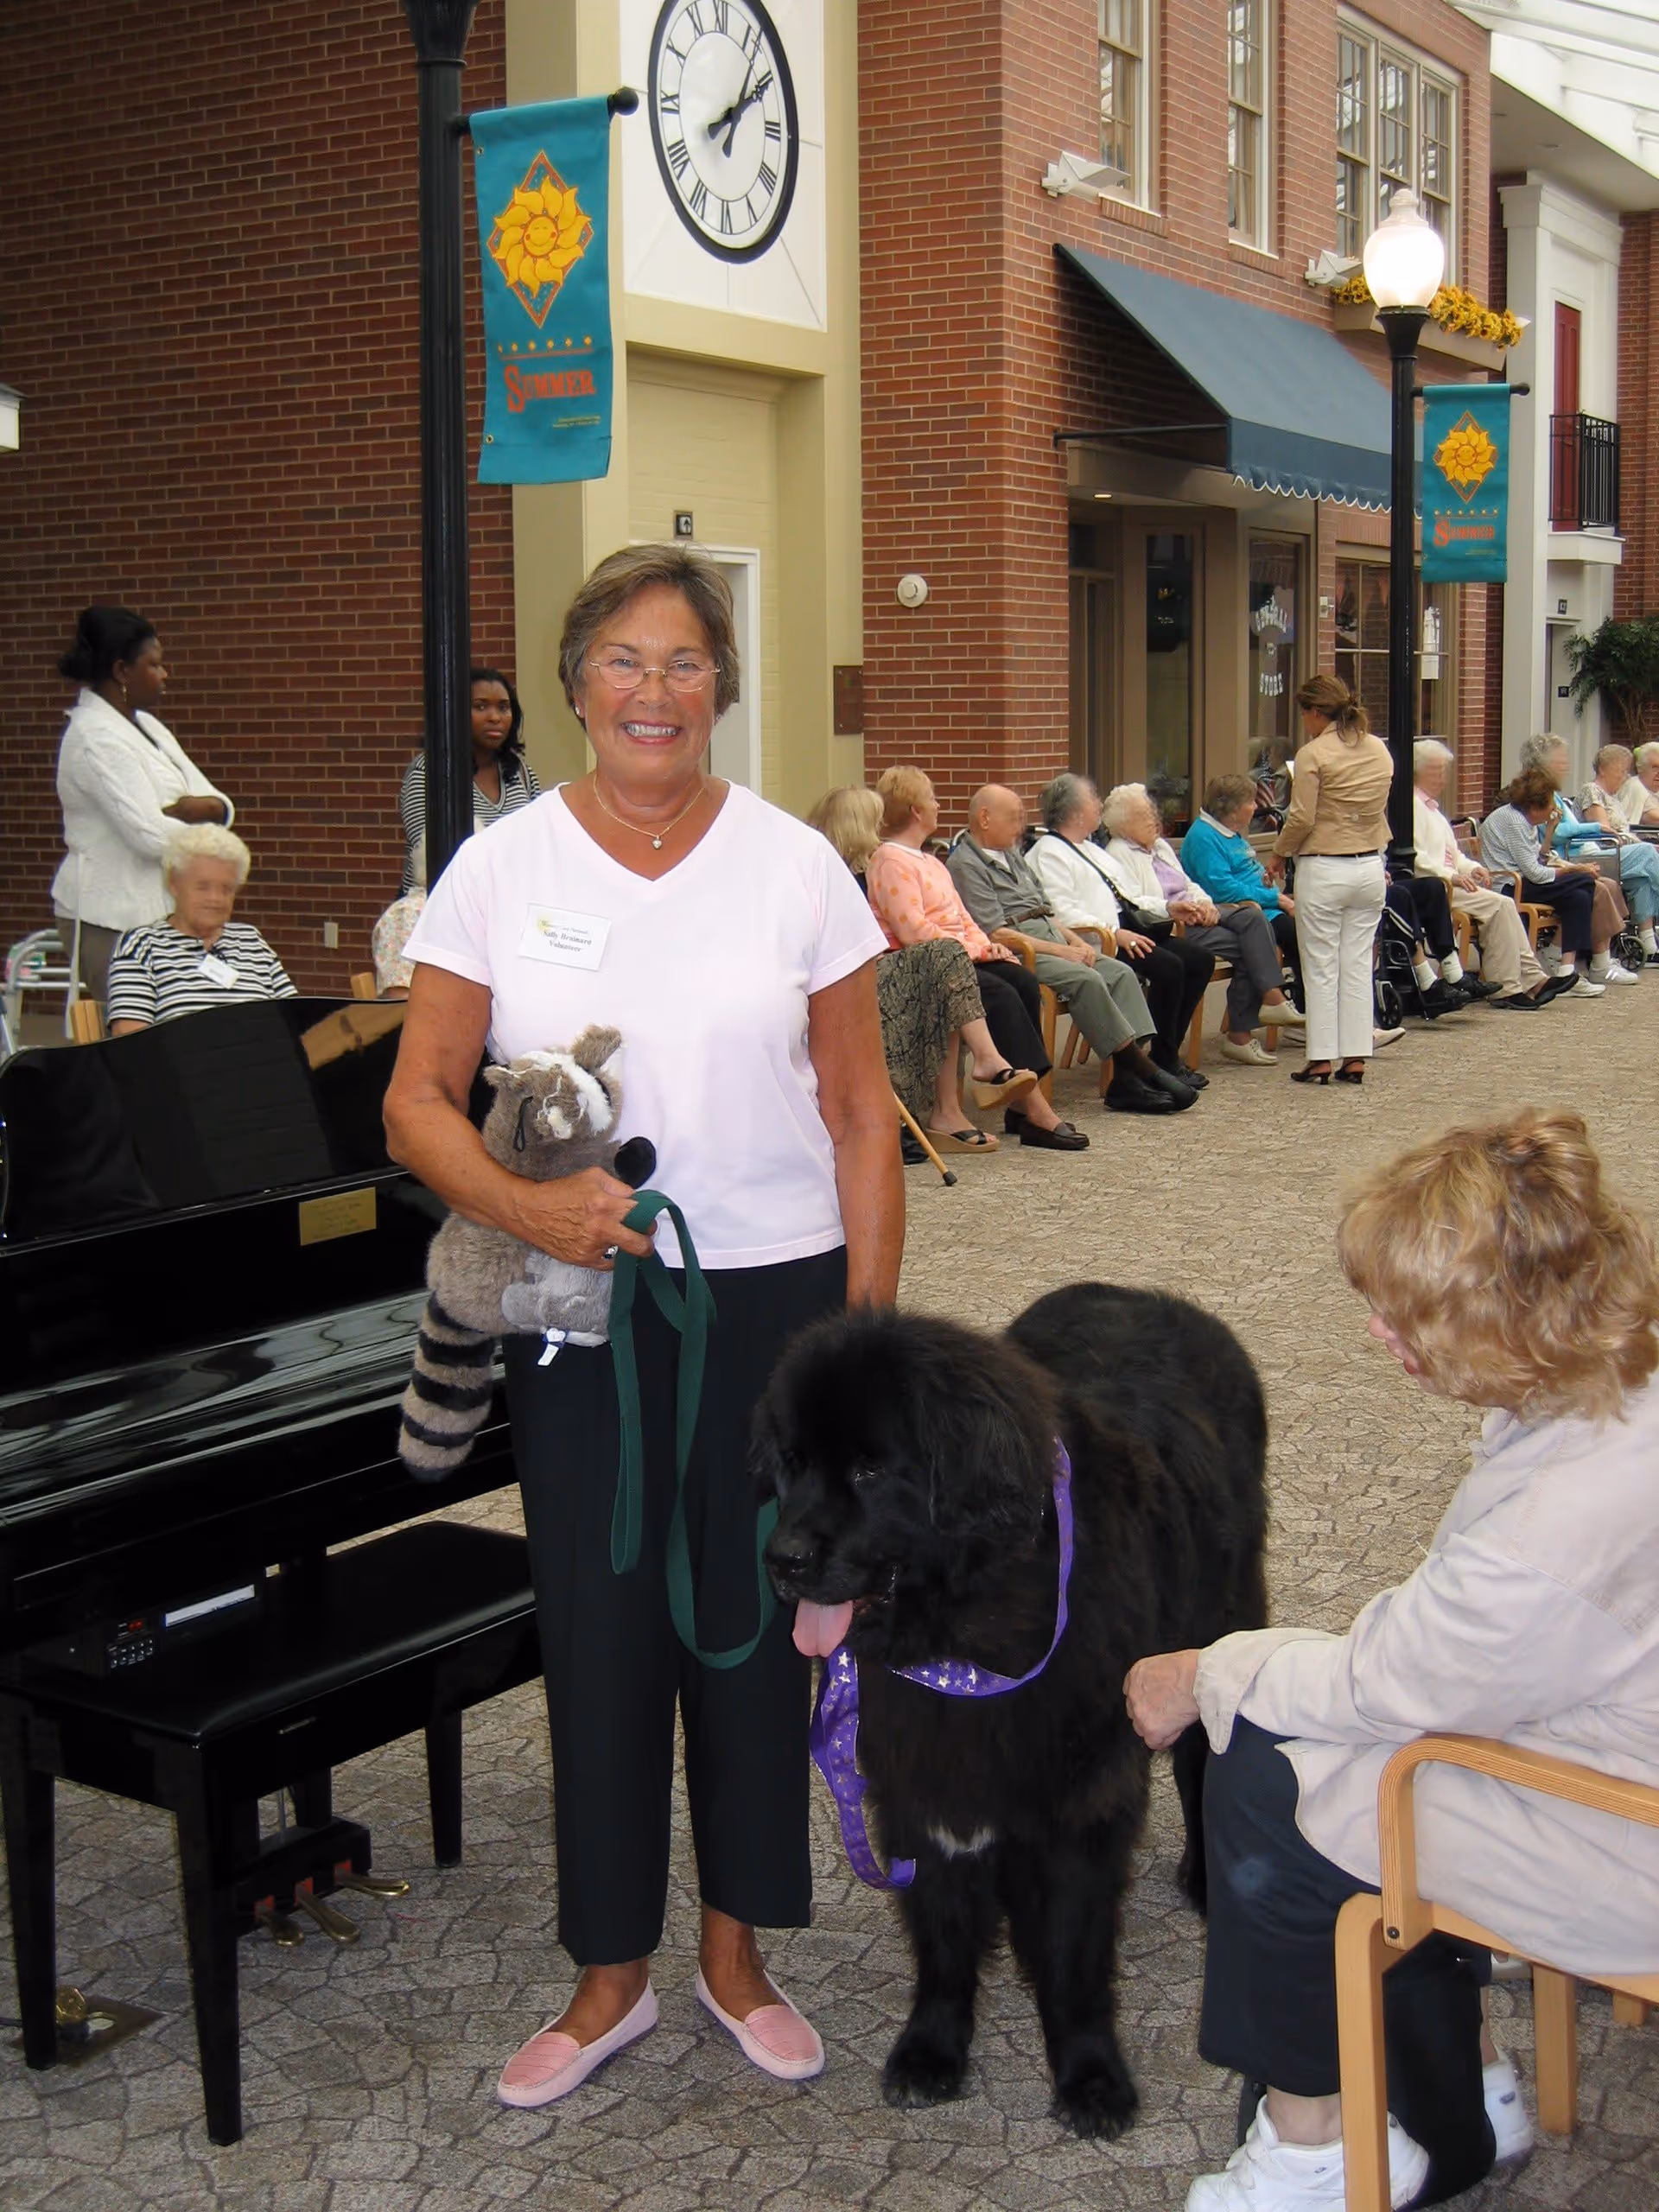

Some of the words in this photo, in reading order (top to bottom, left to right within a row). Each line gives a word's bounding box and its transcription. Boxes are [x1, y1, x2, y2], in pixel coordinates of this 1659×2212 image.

[686, 2, 703, 41] XI
[713, 0, 728, 35] XII
[666, 38, 687, 68] X
[660, 90, 679, 114] IX
[765, 121, 780, 142] III
[668, 138, 690, 181] VIII
[758, 162, 777, 197] IIII
[690, 179, 707, 219] VII
[745, 194, 758, 226] V
[721, 200, 733, 234] VI
[504, 365, 596, 412] SUMMER
[1434, 520, 1495, 546] SUMMER
